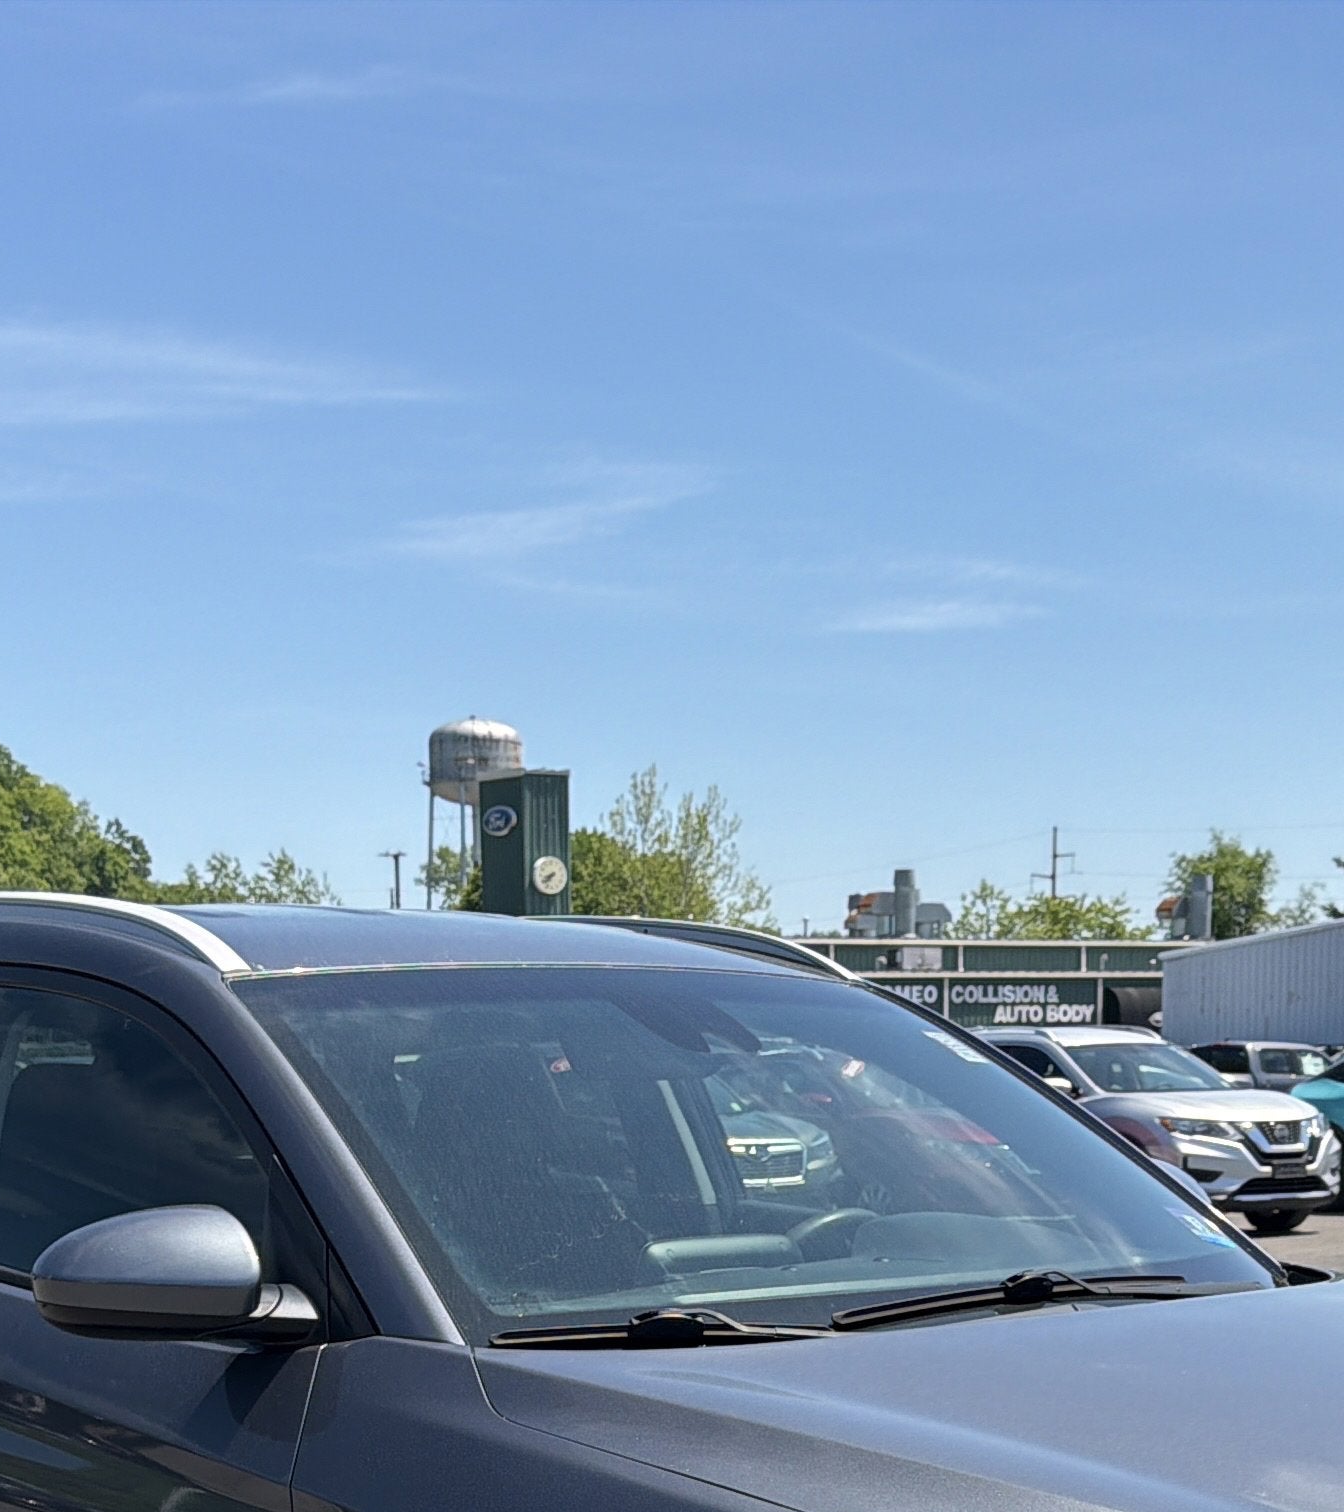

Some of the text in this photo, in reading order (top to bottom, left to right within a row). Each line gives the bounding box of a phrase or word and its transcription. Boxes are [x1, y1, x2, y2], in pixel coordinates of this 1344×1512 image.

[951, 985, 1044, 1004] COLLISION
[1047, 985, 1059, 1003] &
[993, 1004, 1043, 1023] AUTO
[1046, 1004, 1094, 1023] BODY
